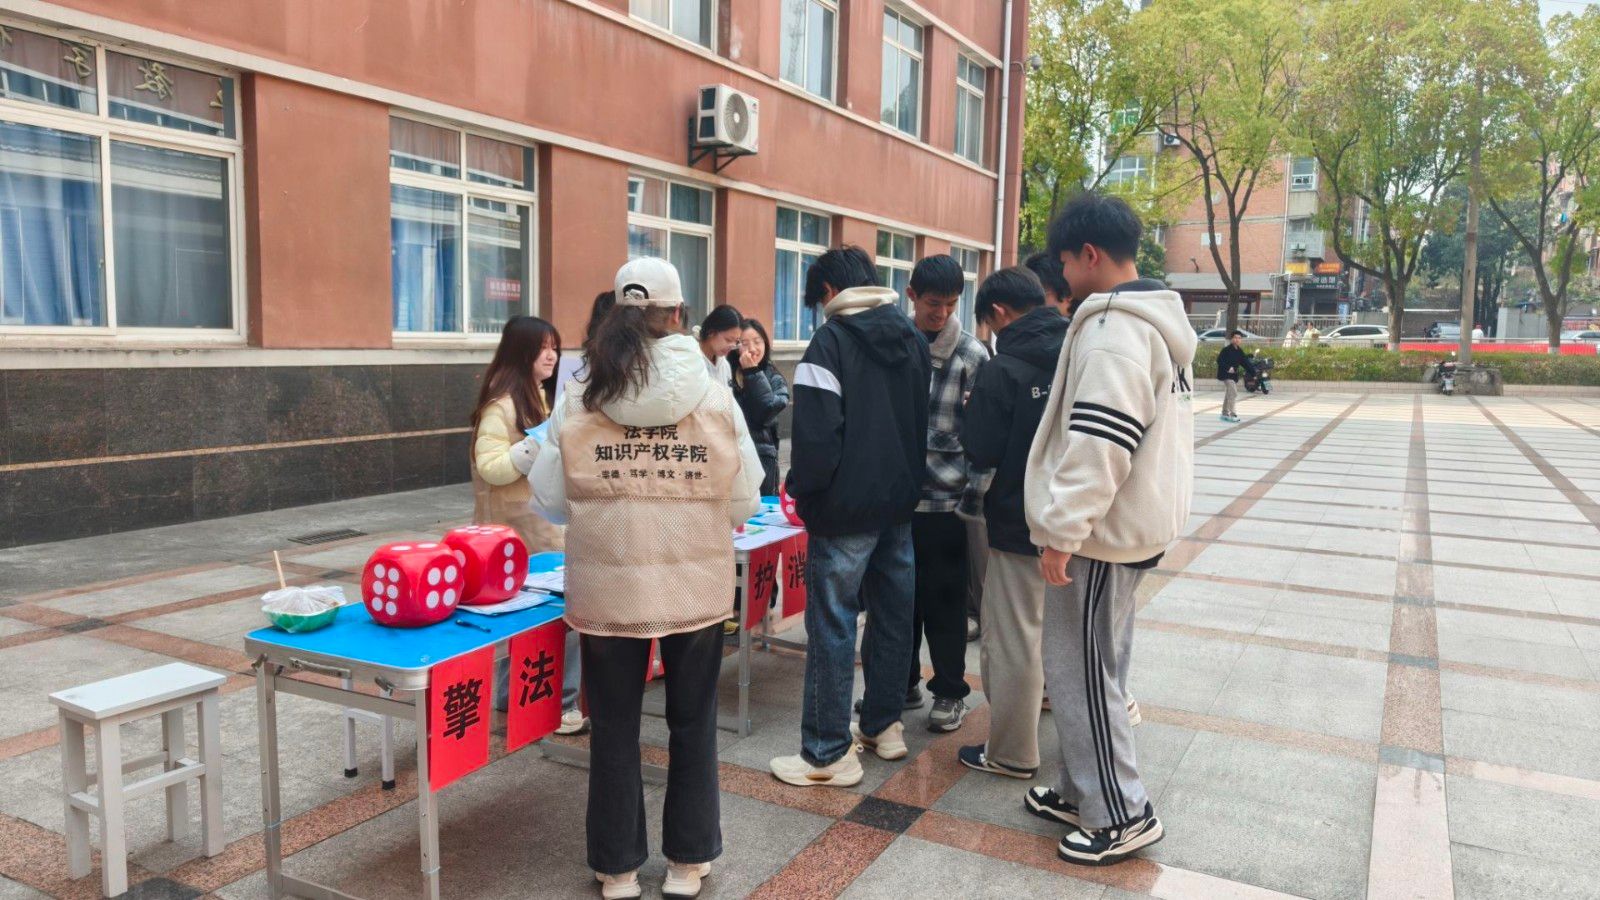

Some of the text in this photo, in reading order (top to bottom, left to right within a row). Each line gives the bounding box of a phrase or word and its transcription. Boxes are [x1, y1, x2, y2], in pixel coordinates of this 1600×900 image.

[624, 424, 678, 440] 法学院
[595, 442, 708, 463] 知识产权学院
[754, 560, 774, 600] 护
[519, 650, 555, 707] 法
[442, 678, 484, 741] 擎
